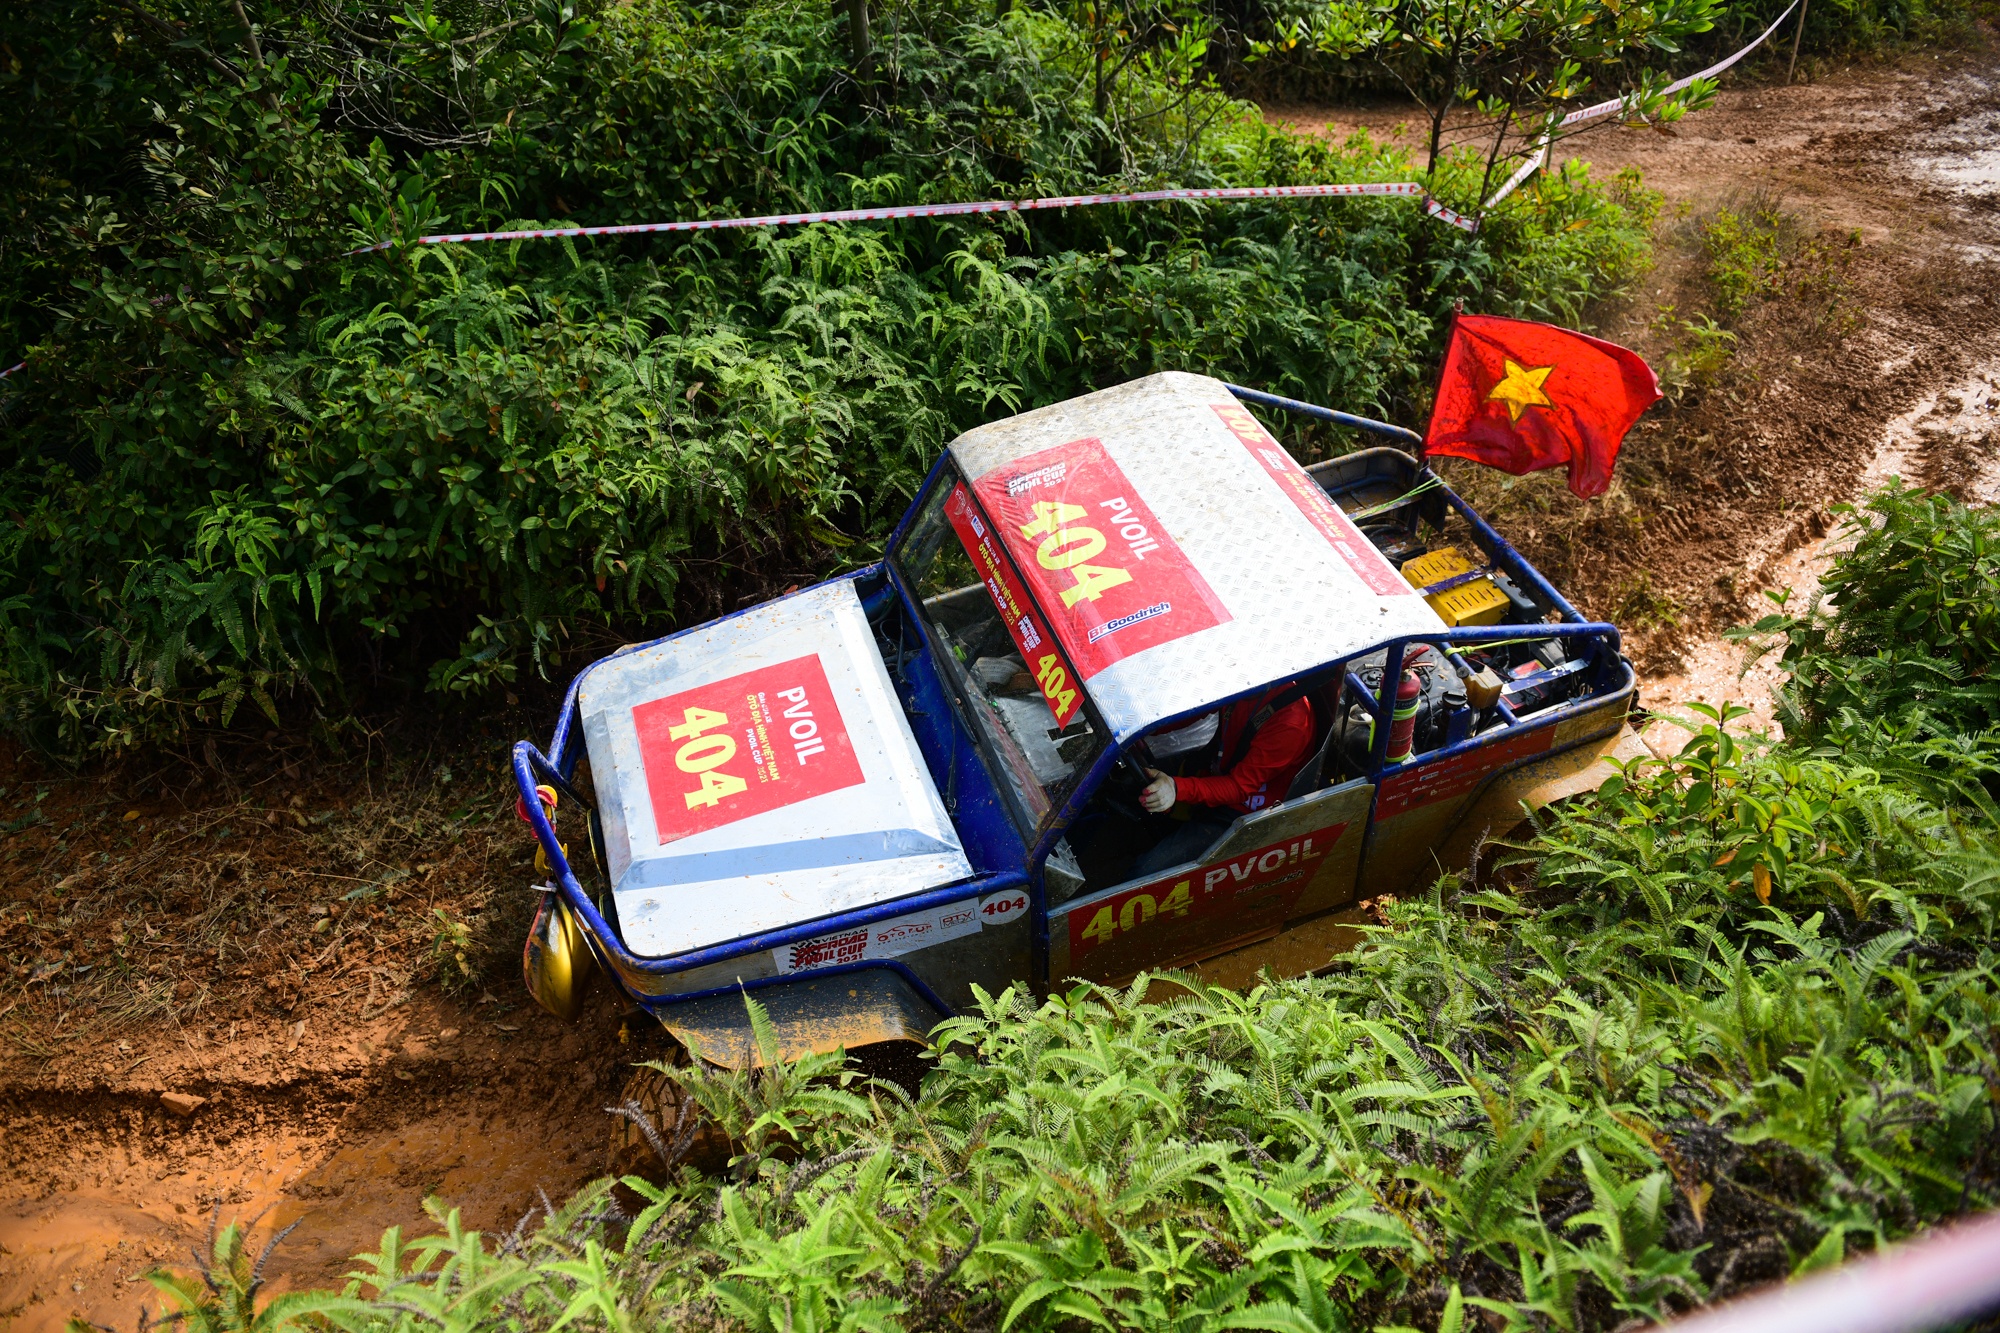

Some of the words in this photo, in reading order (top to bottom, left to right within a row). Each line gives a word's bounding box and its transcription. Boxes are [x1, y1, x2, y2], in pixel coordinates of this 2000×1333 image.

[1008, 462, 1066, 488] OFFROAD
[1008, 479, 1041, 496] PVOIL
[1042, 468, 1067, 484] CUP
[1043, 476, 1066, 488] 2021
[1100, 496, 1159, 560] PVOIL
[1019, 500, 1133, 610] 404
[978, 543, 988, 559] ÔTÔ
[985, 557, 995, 572] ĐỊA
[1000, 584, 1012, 601] VIỆT
[1009, 600, 1021, 618] NAM
[987, 577, 999, 597] PVOIL
[997, 596, 1007, 609] CUP
[1089, 602, 1170, 638] BFGoodrich
[1026, 636, 1036, 649] CUP
[1036, 653, 1076, 719] 404
[747, 694, 759, 710] ÔTÔ
[751, 711, 762, 724] ĐỊA
[777, 685, 825, 766] PVOIL
[756, 723, 768, 743] HÌNH
[669, 706, 748, 810] 404
[746, 728, 758, 750] PVOIL
[752, 749, 762, 765] CUP
[761, 743, 774, 762] VIỆT
[767, 760, 780, 781] NAM
[1204, 838, 1321, 893] PVOIL
[982, 896, 1026, 916] 404
[1081, 880, 1195, 945] 404
[796, 932, 869, 958] OFFROAD
[820, 928, 868, 943] VIETNAM
[795, 947, 836, 968] PVOIL
[837, 942, 867, 958] CUP
[836, 953, 863, 965] 2021
